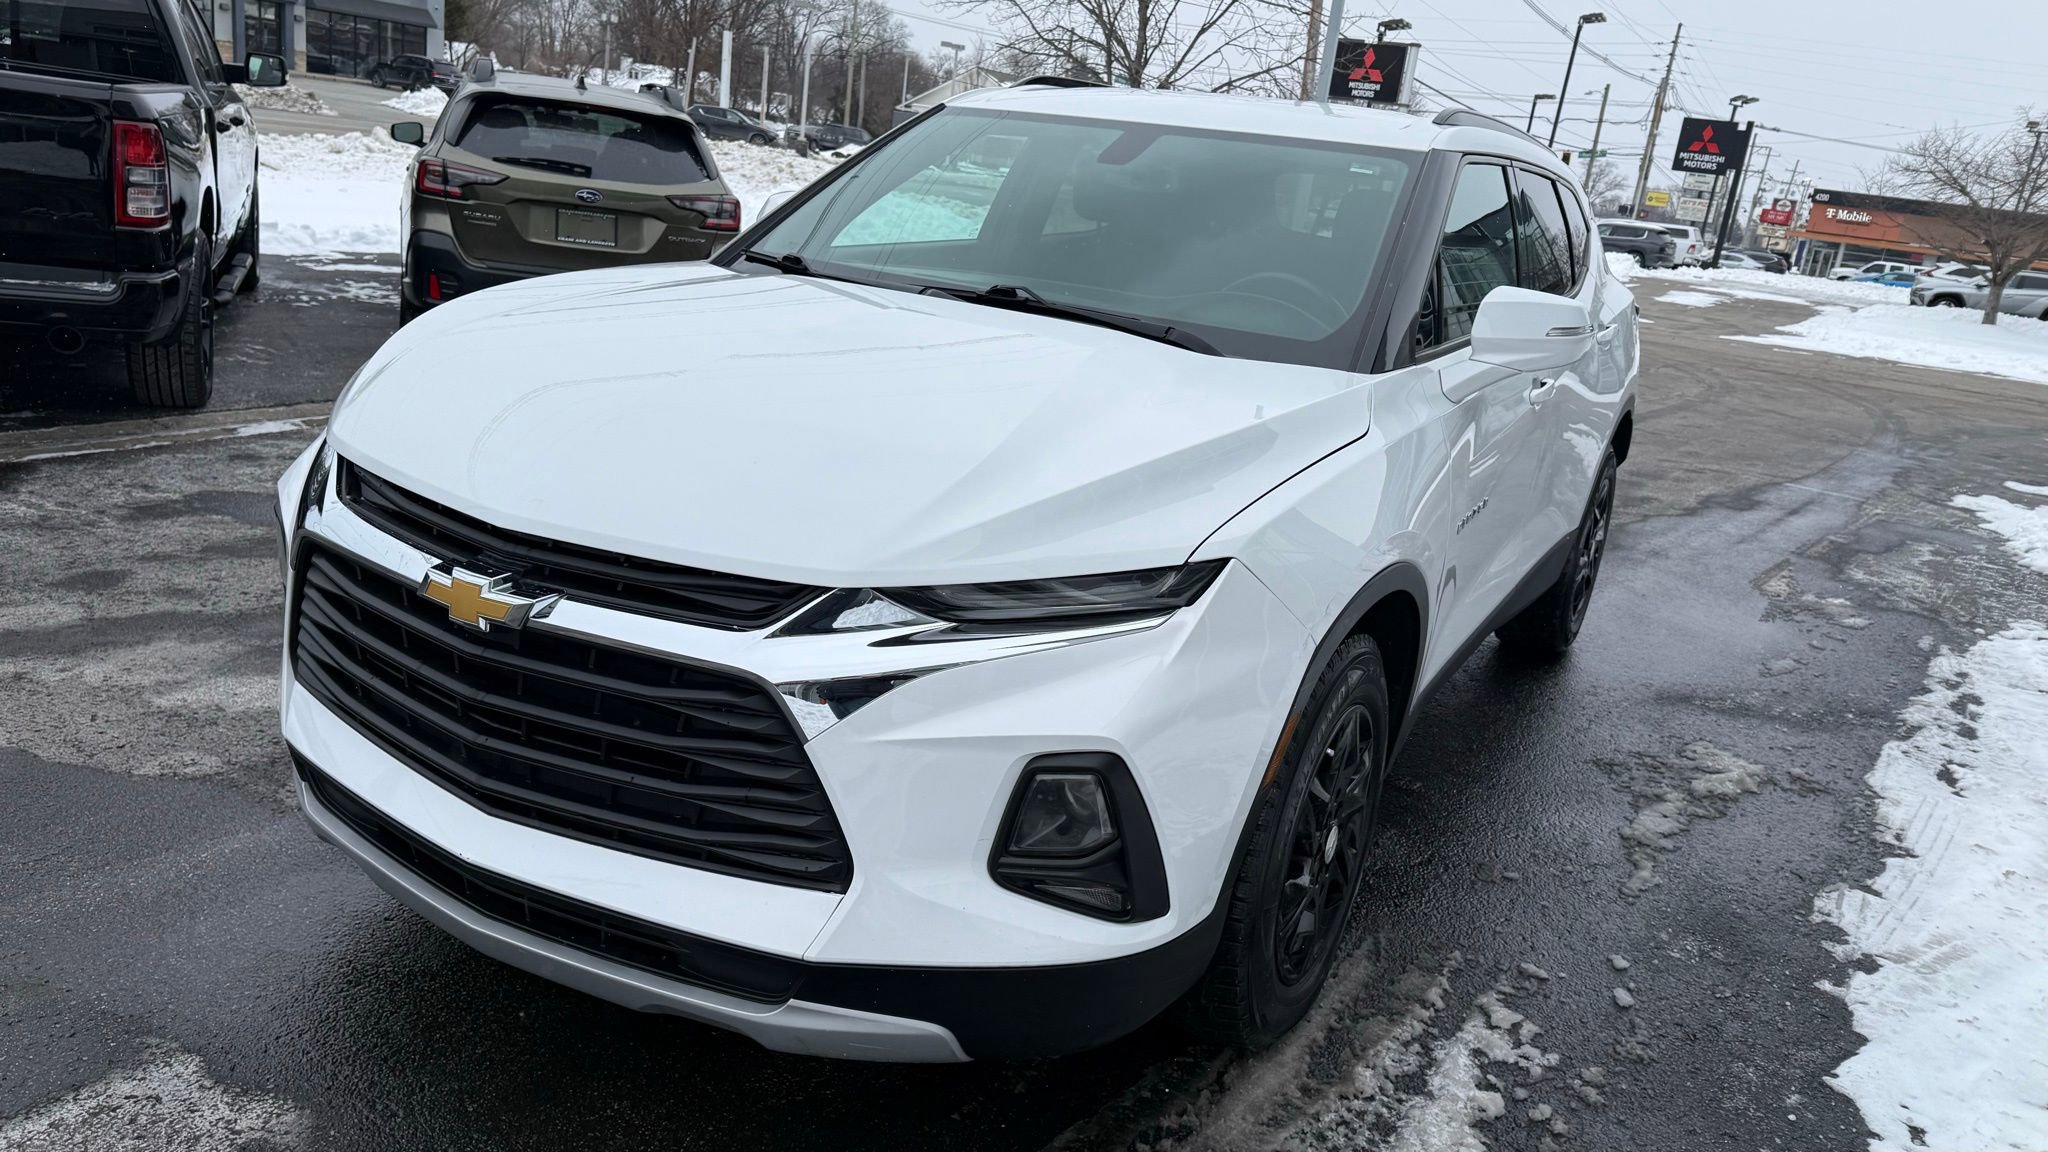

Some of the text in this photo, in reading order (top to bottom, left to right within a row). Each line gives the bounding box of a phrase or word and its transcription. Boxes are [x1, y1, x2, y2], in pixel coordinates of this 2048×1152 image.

[1348, 81, 1381, 91] MITSUBISHI
[1351, 89, 1375, 98] MOTORS
[1679, 152, 1726, 163] MITSUBISHI
[1683, 160, 1718, 170] MOTORS
